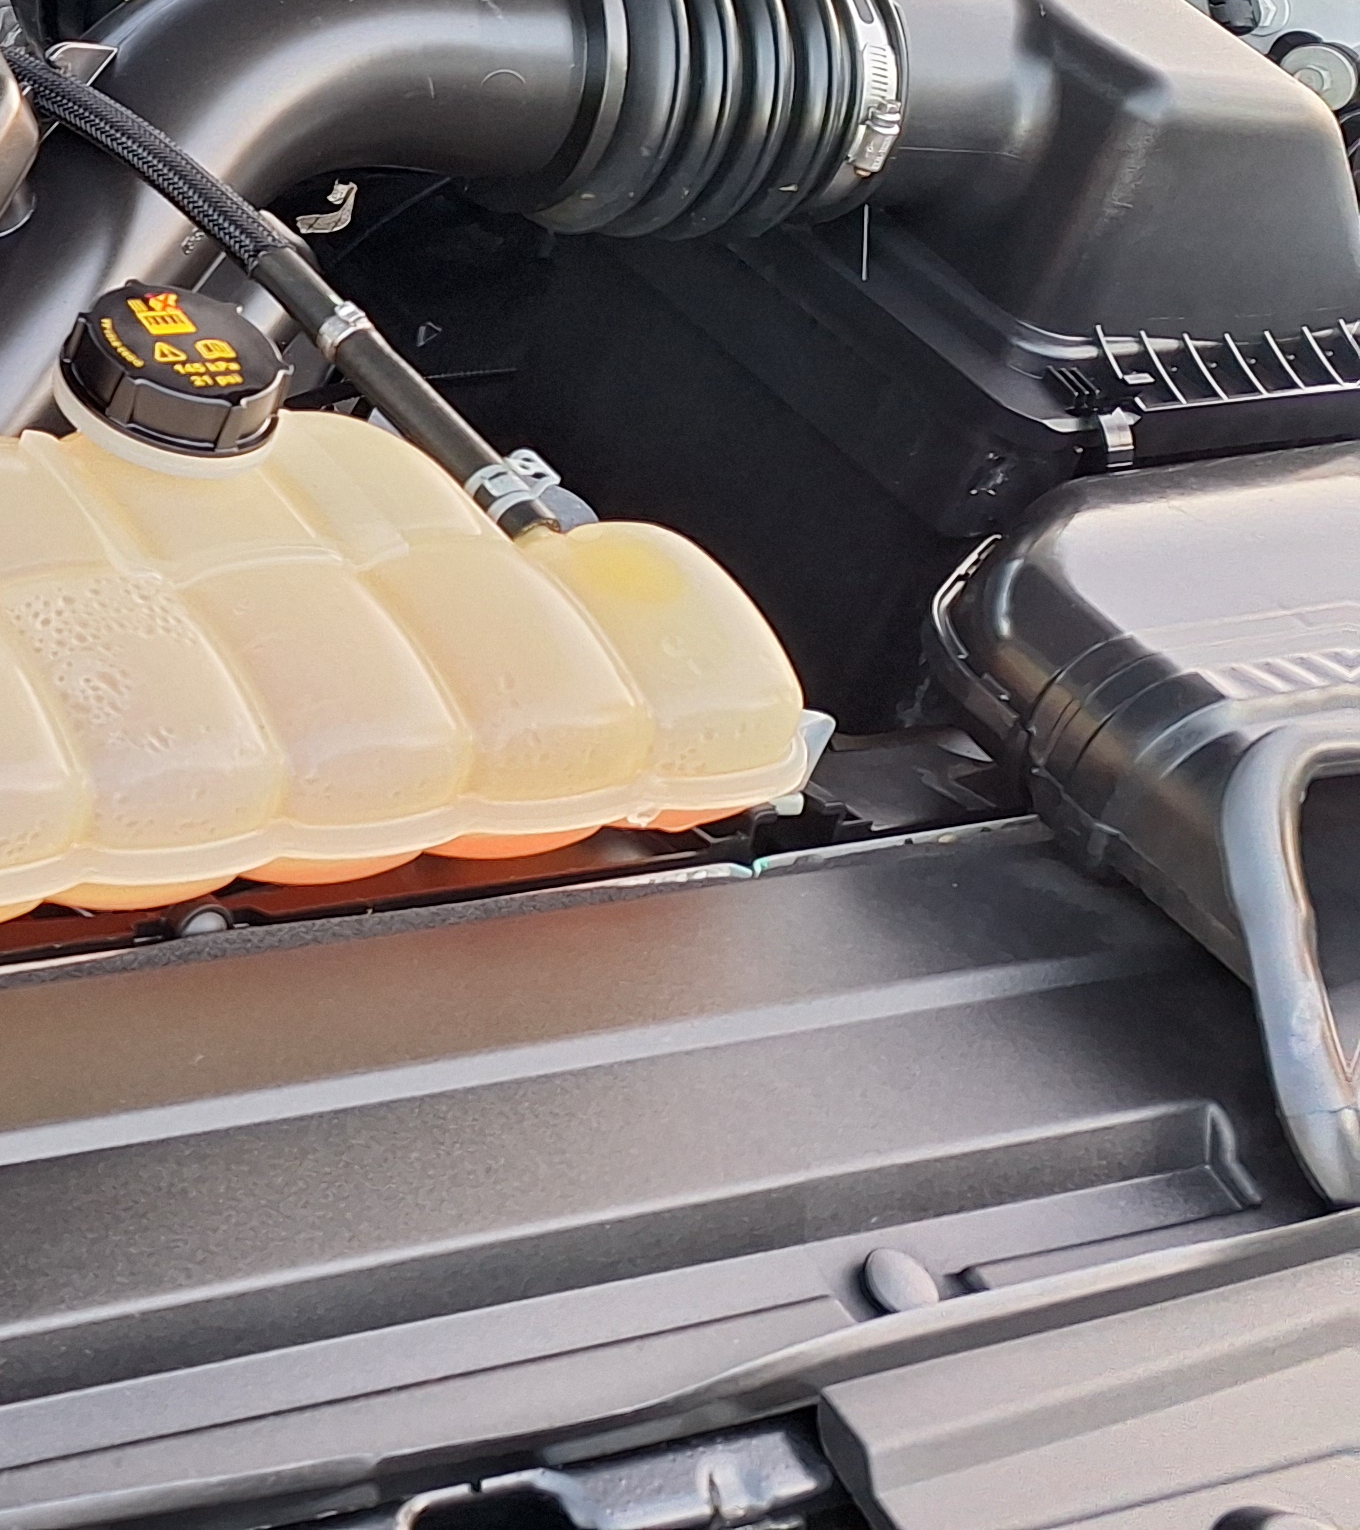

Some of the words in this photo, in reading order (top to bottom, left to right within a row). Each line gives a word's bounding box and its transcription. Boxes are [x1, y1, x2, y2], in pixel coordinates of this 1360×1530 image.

[173, 362, 206, 374] 145
[209, 361, 241, 372] kPa
[189, 375, 214, 387] 21
